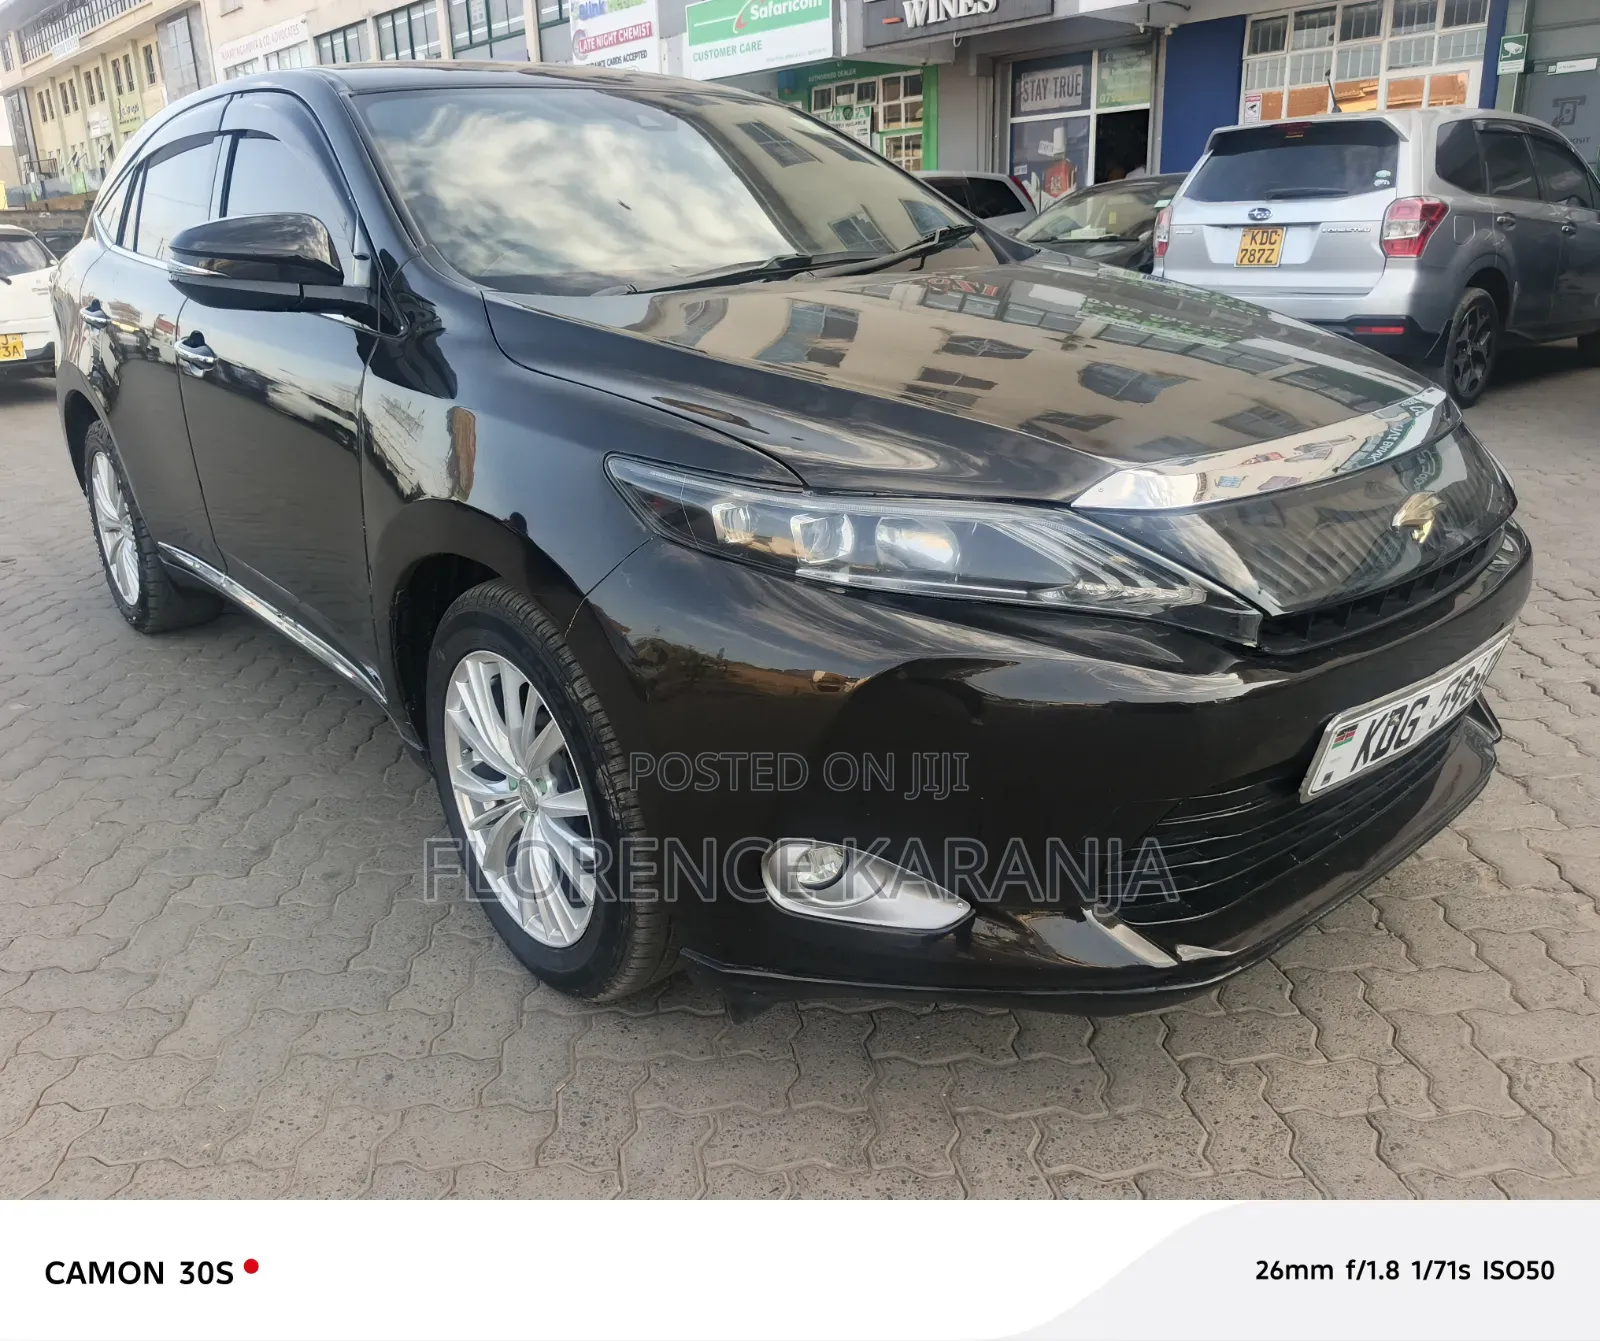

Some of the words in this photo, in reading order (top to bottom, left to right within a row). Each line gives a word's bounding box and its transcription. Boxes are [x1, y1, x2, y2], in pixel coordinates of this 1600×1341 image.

[750, 0, 822, 20] Safaricom
[903, 0, 996, 28] WINES
[579, 37, 596, 53] LATE
[595, 31, 617, 48] NIGHT
[618, 23, 651, 42] CHEMIST
[606, 56, 622, 67] CARDS
[623, 50, 648, 63] ACCEPTED
[693, 45, 737, 62] CUSTOMER
[739, 40, 762, 54] CARE
[837, 68, 856, 77] DEALER
[1023, 78, 1049, 102] STAY
[1053, 73, 1082, 99] TRUE
[1250, 230, 1277, 246] KDC
[1239, 248, 1275, 264] 787Z
[1350, 694, 1430, 772] KDG
